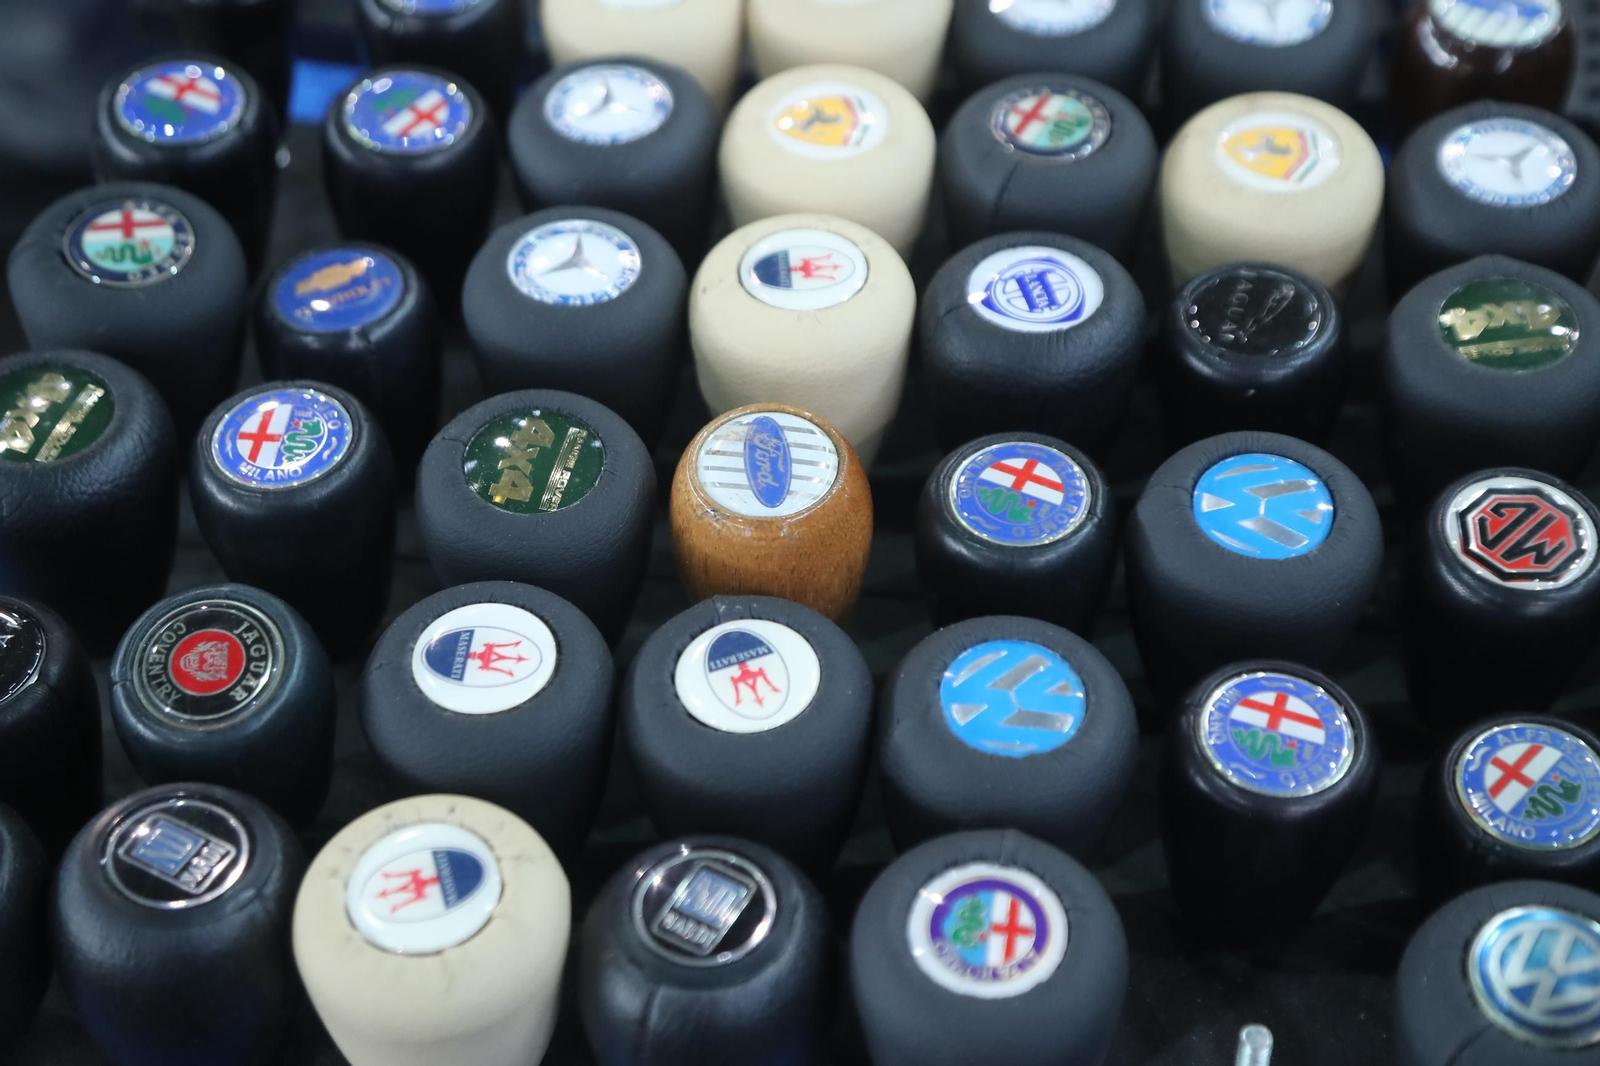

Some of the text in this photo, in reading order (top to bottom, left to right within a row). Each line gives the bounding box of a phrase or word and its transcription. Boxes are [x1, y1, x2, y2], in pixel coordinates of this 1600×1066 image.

[1025, 274, 1051, 309] LANCIA
[238, 461, 303, 482] MILANO
[754, 434, 784, 489] Ford
[959, 452, 995, 499] MILANO
[1477, 501, 1567, 566] MG
[148, 621, 187, 705] COVENTRY
[229, 621, 268, 702] JAGUAR
[451, 631, 471, 679] MASERATI
[709, 644, 770, 671] MASERATI
[1209, 686, 1242, 745] MILANO
[1496, 728, 1552, 747] ALFA
[1470, 791, 1537, 841] MILANO
